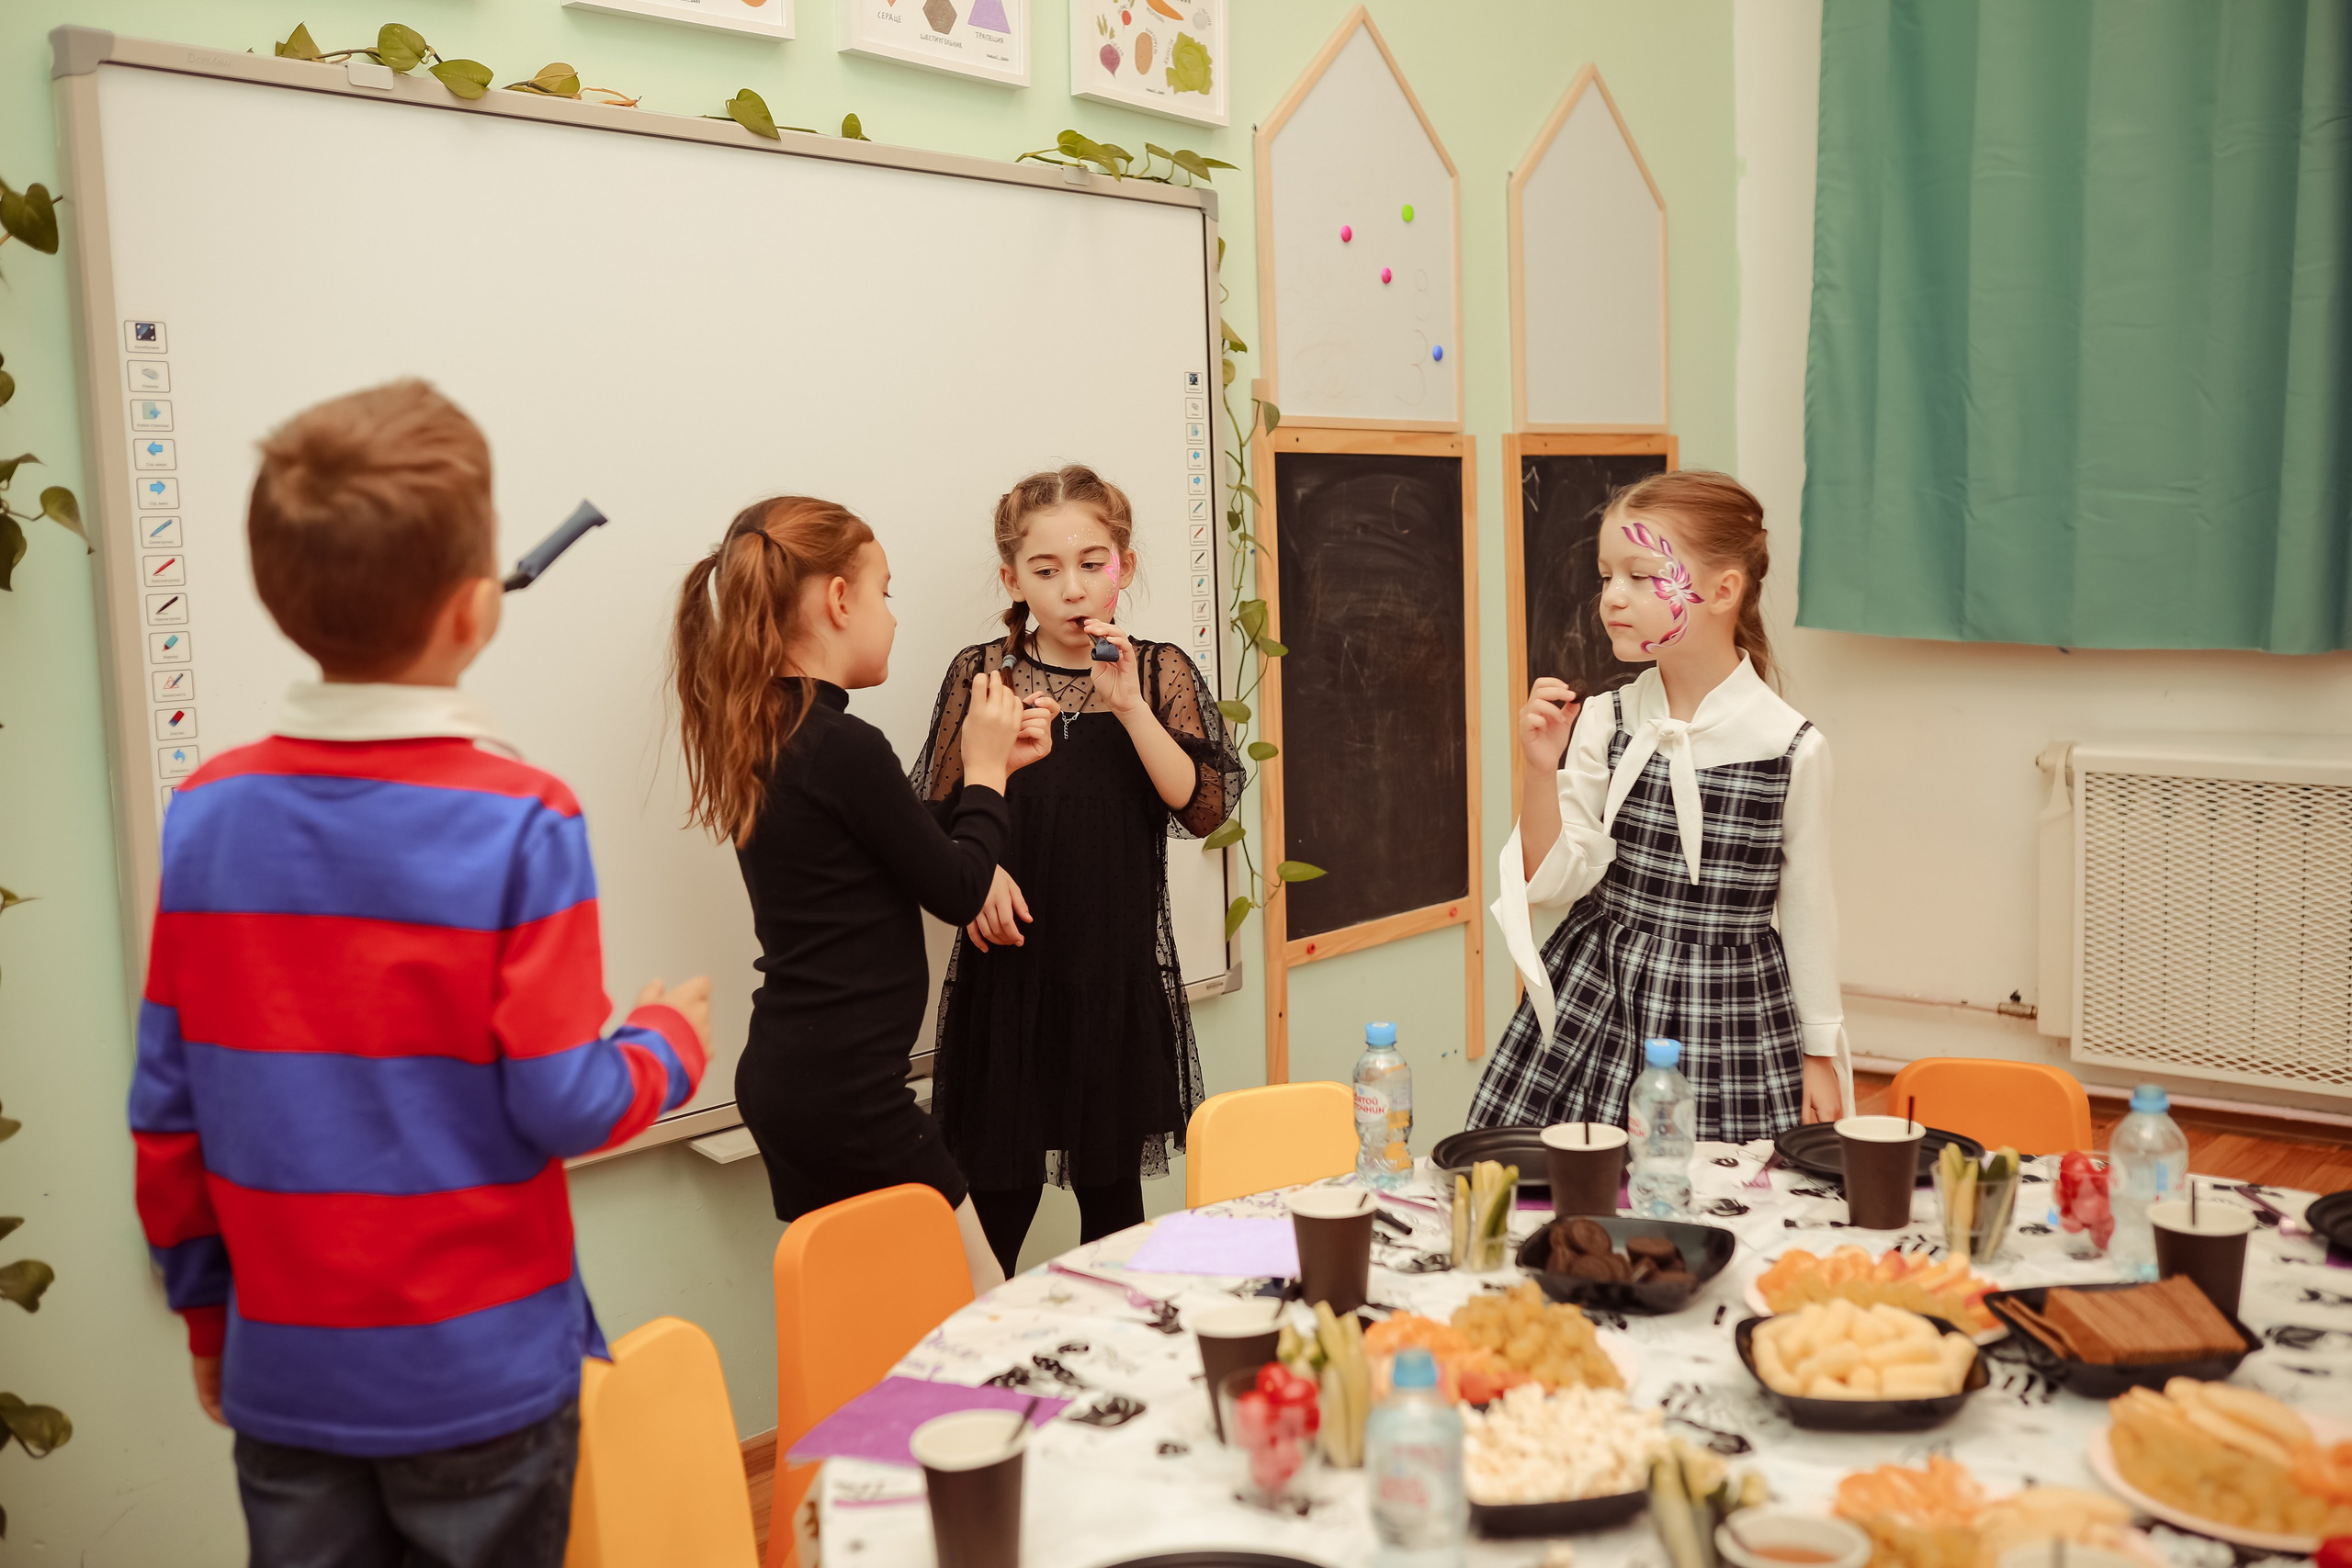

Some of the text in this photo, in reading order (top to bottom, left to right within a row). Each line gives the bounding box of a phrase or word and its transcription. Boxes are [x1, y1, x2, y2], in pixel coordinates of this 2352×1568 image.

[876, 10, 902, 24] СЕРДЦЕ
[920, 33, 963, 49] ШЕСТИУГОЛЬНИК
[975, 31, 1004, 44] ТРАПЕЦИЯ
